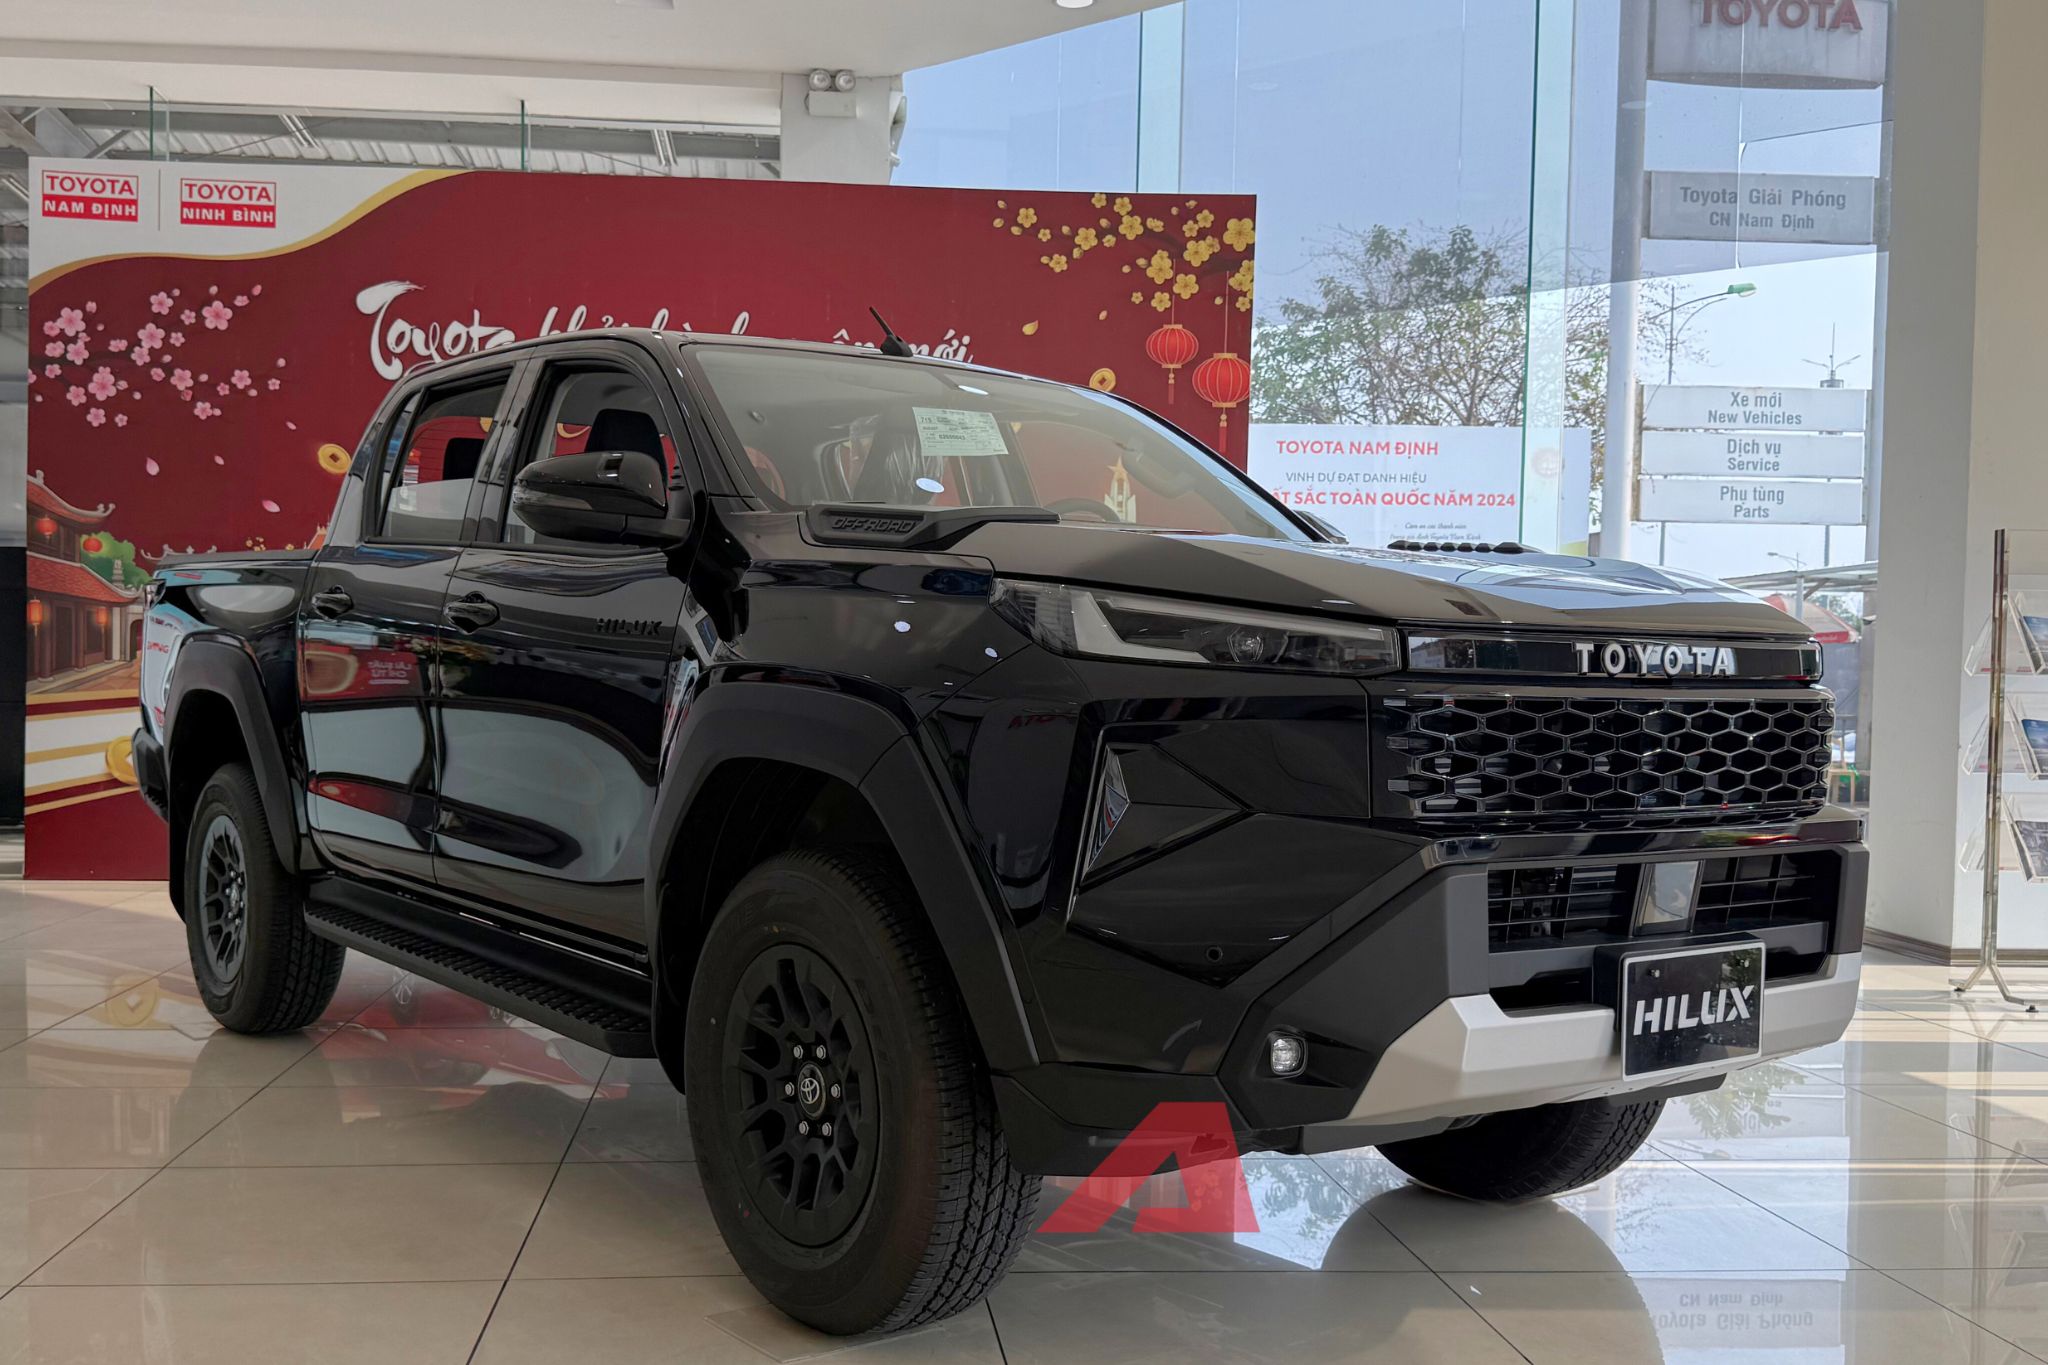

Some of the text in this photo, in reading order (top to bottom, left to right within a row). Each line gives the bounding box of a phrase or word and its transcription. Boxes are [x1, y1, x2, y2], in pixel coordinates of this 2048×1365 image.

[1703, 0, 1863, 30] TOYOTA
[46, 175, 134, 196] TOYOTA
[184, 183, 272, 202] TOYOTA
[1680, 186, 1846, 210] Toyota Giải Phóng
[44, 200, 136, 218] NAM ĐỊNH
[182, 206, 274, 223] NINH BÌNH
[1709, 211, 1814, 231] CN Nam Định
[1731, 391, 1782, 408] Xe mới
[1708, 409, 1802, 425] New Vehicles
[1276, 440, 1438, 459] TOYOTA NAM ĐỊNH
[1727, 438, 1782, 458] Dịch vụ
[1727, 457, 1780, 471] Service
[1286, 471, 1427, 485] VINH DỰ ĐẠT DANH HIỆU
[1294, 484, 1327, 505] SẮC
[1330, 488, 1376, 505] TOÀN
[1381, 488, 1430, 506] QUỐC
[1434, 489, 1472, 506] NĂM
[1476, 493, 1516, 507] 2024
[1720, 485, 1784, 505] Phụ tùng
[1734, 504, 1769, 518] Parts
[595, 618, 662, 635] HILUX
[1573, 641, 1732, 678] TOYOTA
[1633, 985, 1755, 1036] HILUX
